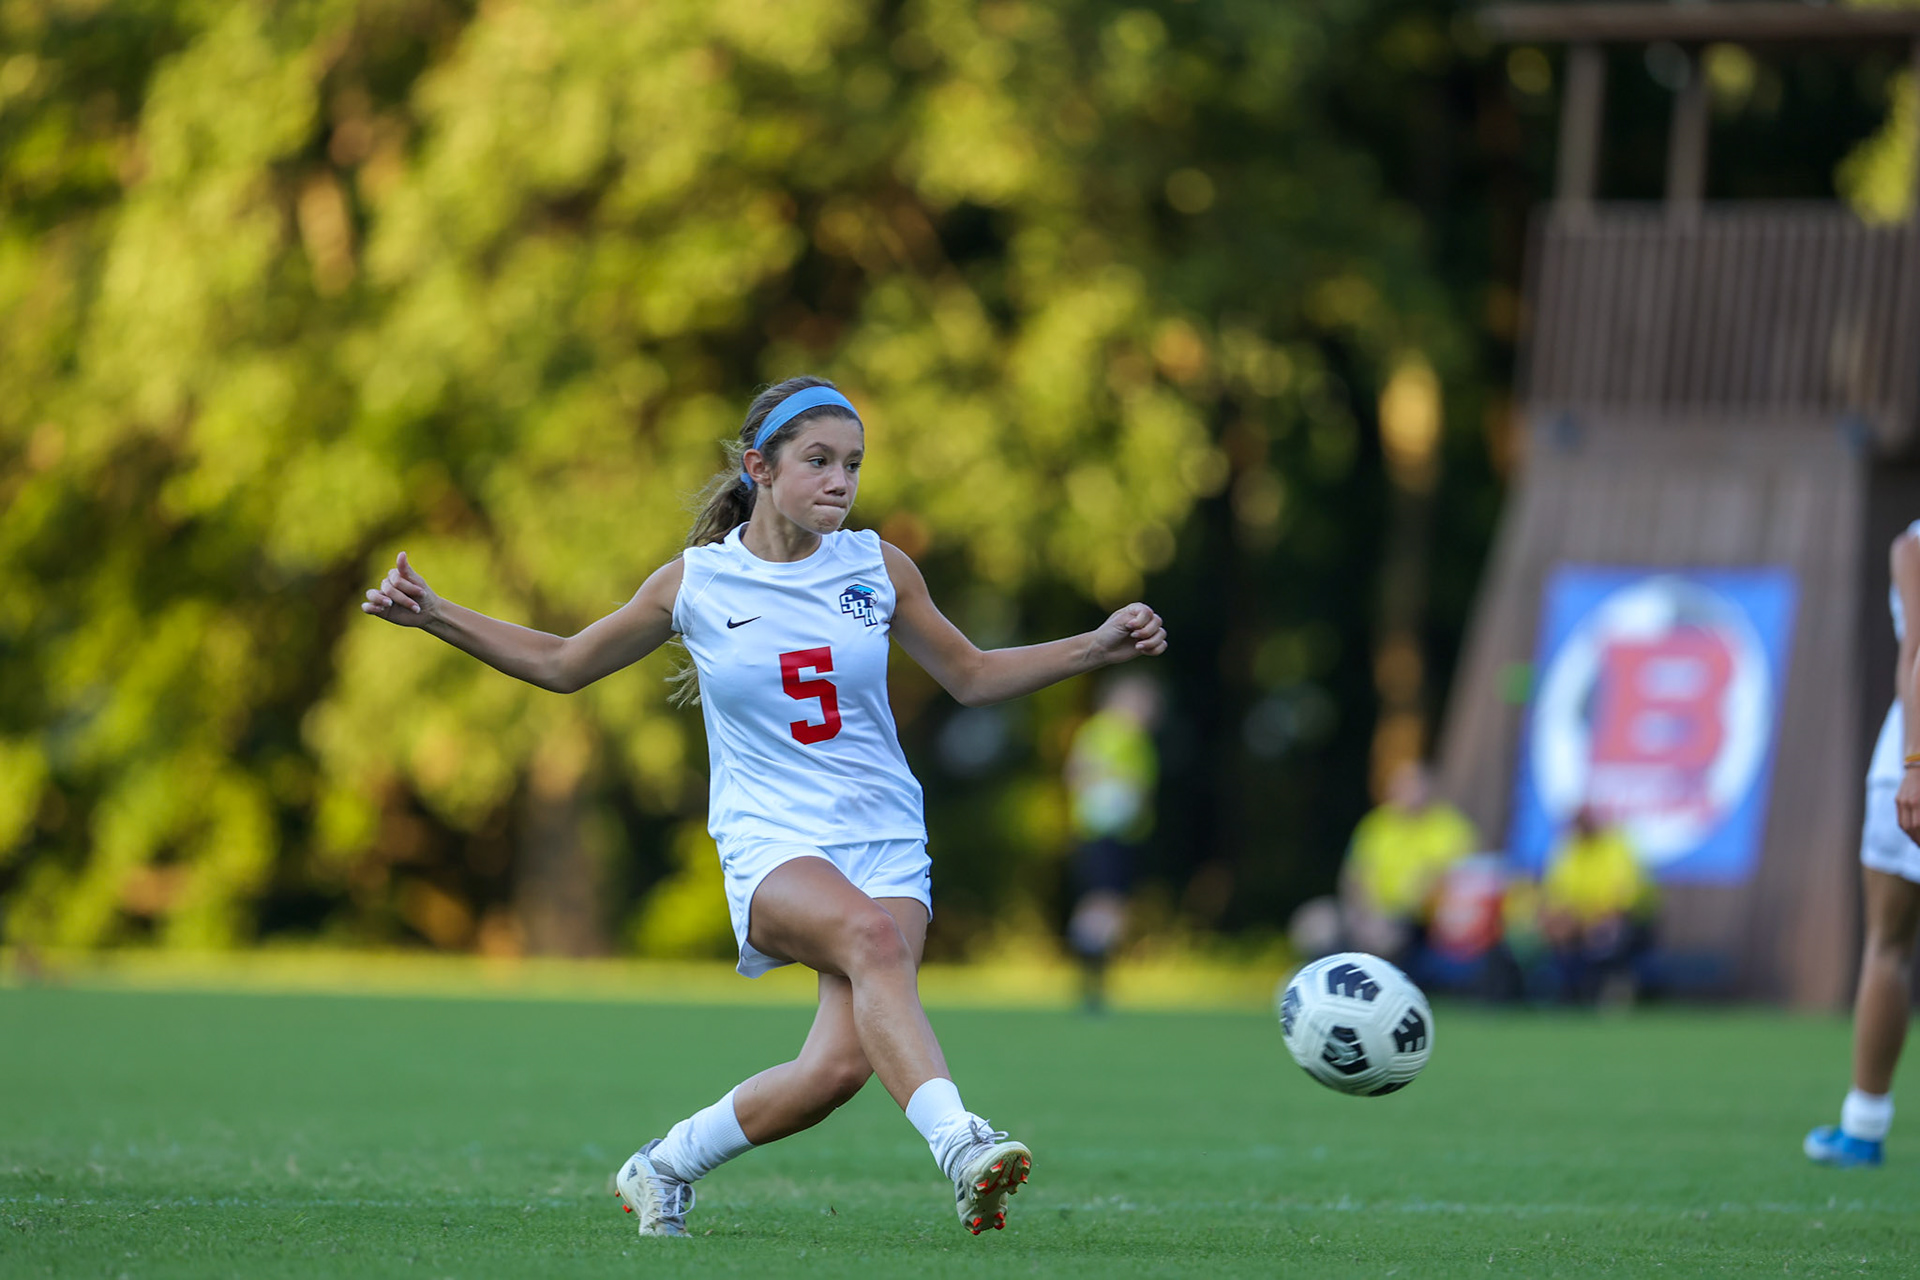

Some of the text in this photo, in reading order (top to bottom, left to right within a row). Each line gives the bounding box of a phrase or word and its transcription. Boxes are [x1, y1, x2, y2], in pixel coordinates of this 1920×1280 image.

[839, 593, 878, 627] SBA
[779, 646, 842, 745] 5
[1591, 627, 1735, 766] B
